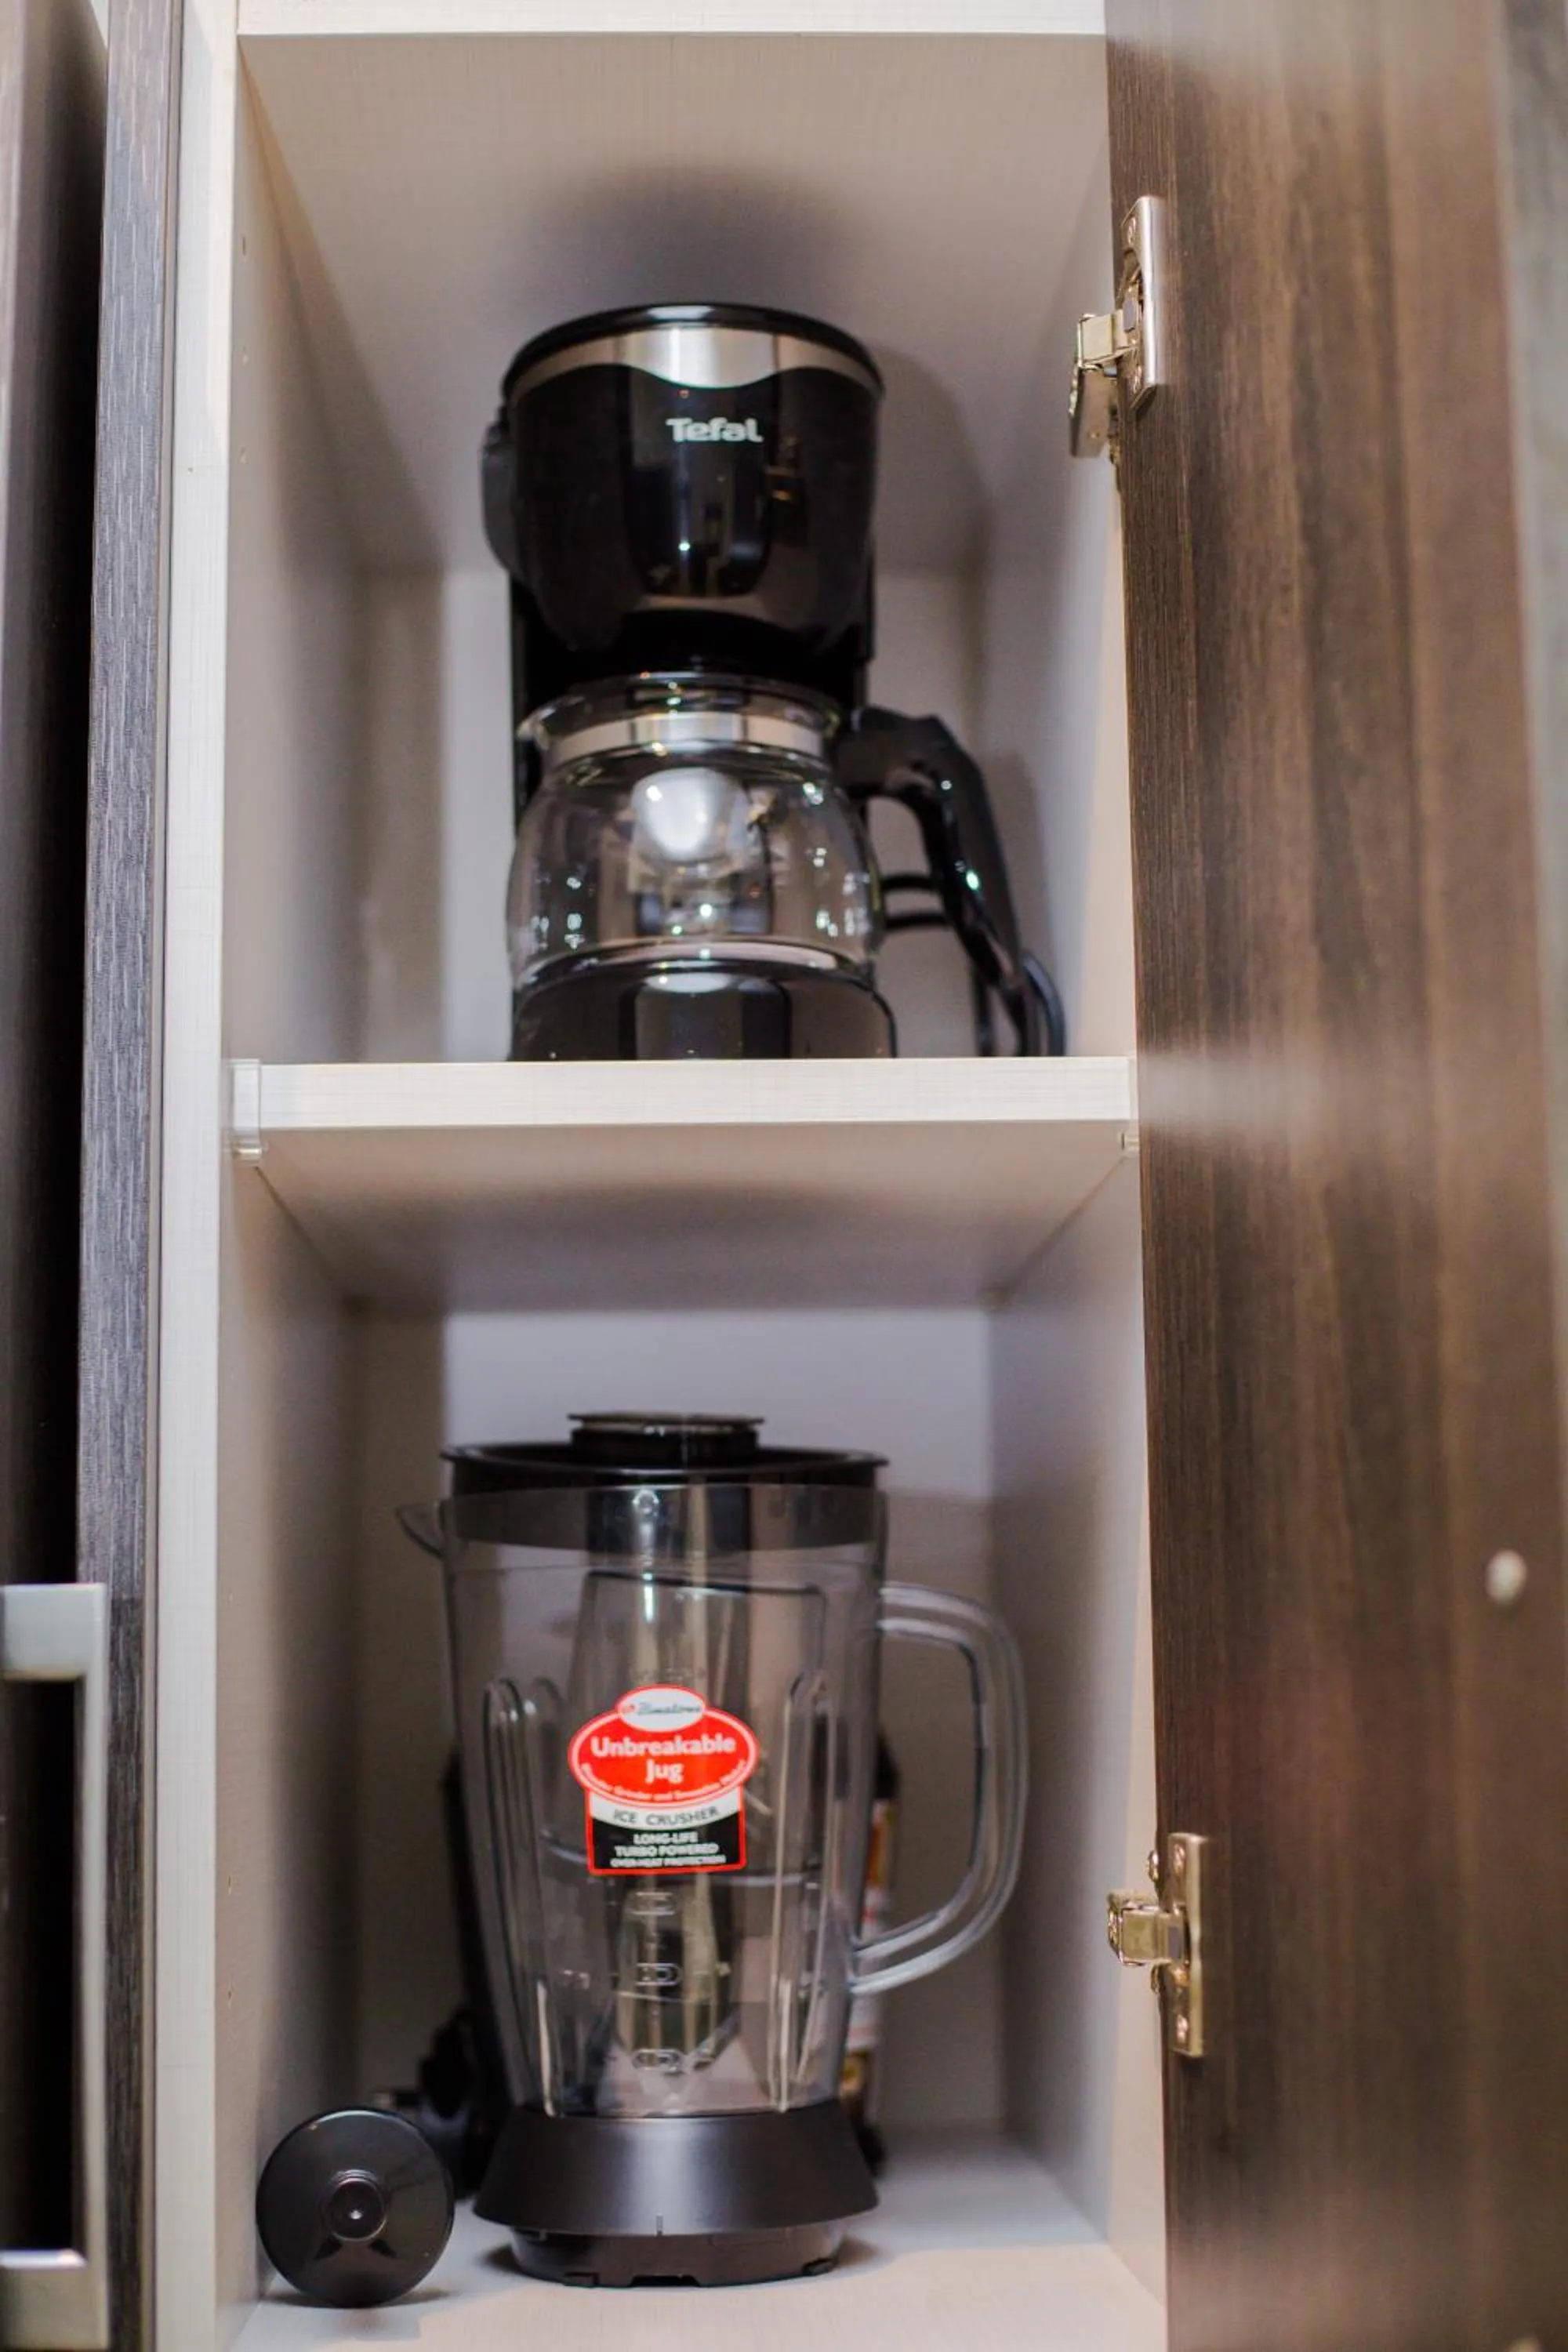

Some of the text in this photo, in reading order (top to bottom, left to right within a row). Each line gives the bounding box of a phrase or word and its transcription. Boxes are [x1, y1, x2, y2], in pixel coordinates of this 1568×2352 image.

[666, 417, 764, 443] Tefal
[590, 1733, 736, 1758] Unbreakable
[613, 1806, 719, 1826] ICE CRUSHER
